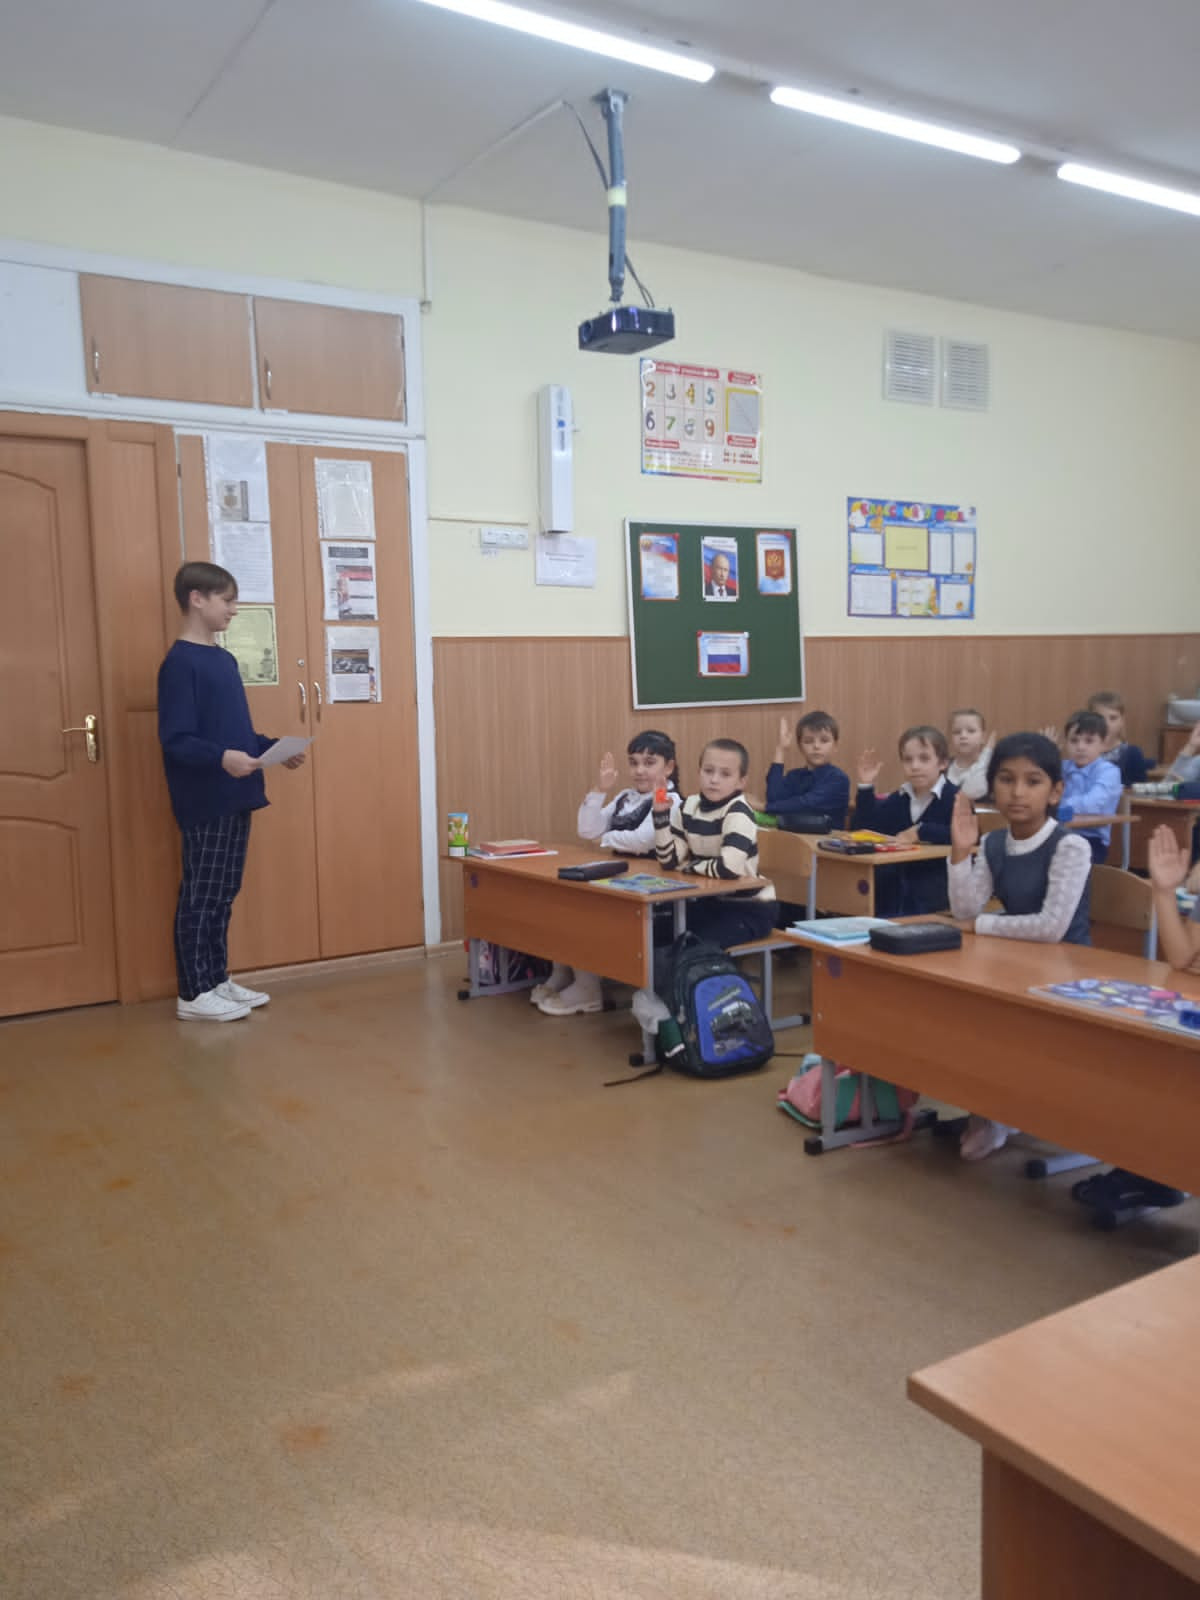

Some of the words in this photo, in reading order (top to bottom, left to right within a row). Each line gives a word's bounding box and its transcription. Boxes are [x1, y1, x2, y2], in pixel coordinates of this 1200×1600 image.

[646, 381, 656, 397] 2
[666, 384, 676, 400] 3
[685, 383, 695, 405] 4
[706, 387, 715, 404] 5
[646, 410, 655, 430] 6
[666, 416, 676, 430] 7
[705, 419, 715, 436] 9
